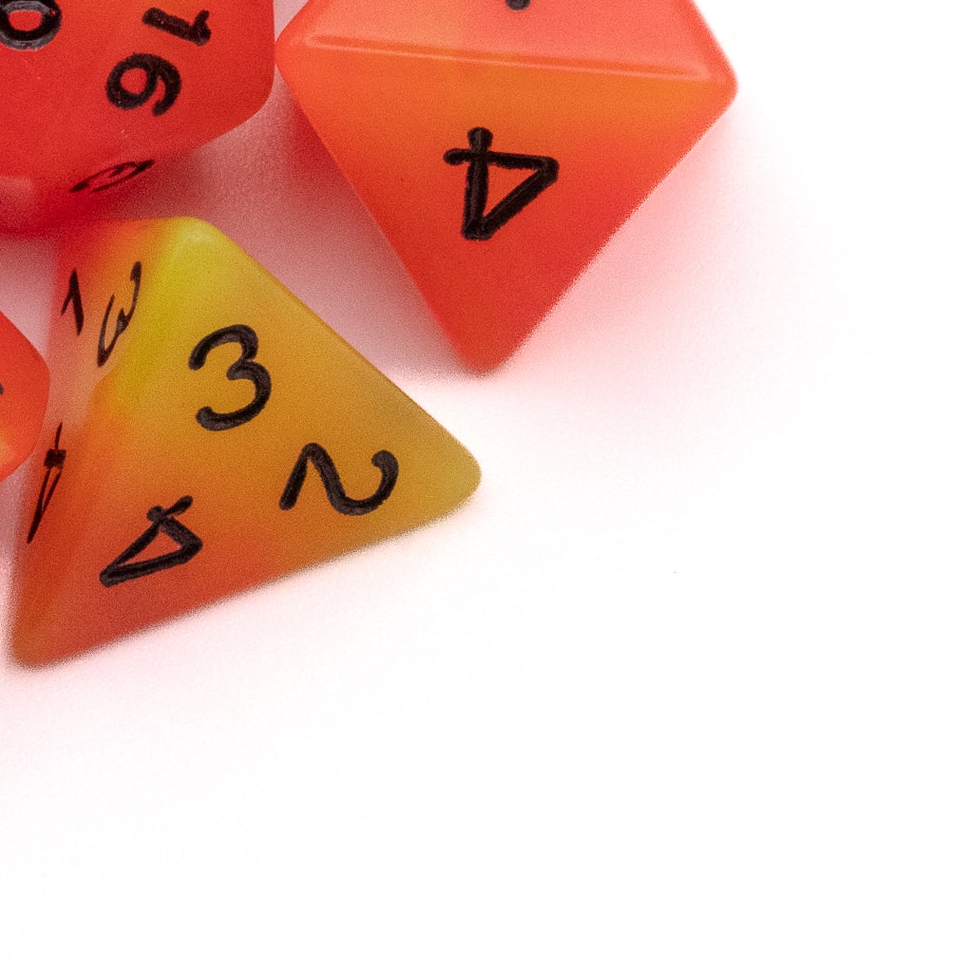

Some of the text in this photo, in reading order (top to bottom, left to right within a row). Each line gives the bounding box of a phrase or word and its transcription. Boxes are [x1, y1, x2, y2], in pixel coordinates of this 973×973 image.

[104, 6, 213, 117] 16
[443, 126, 560, 242] 4
[61, 269, 85, 335] 1
[97, 261, 143, 368] 3
[188, 324, 273, 432] 3
[279, 442, 400, 516] 2
[99, 495, 204, 589] 4
